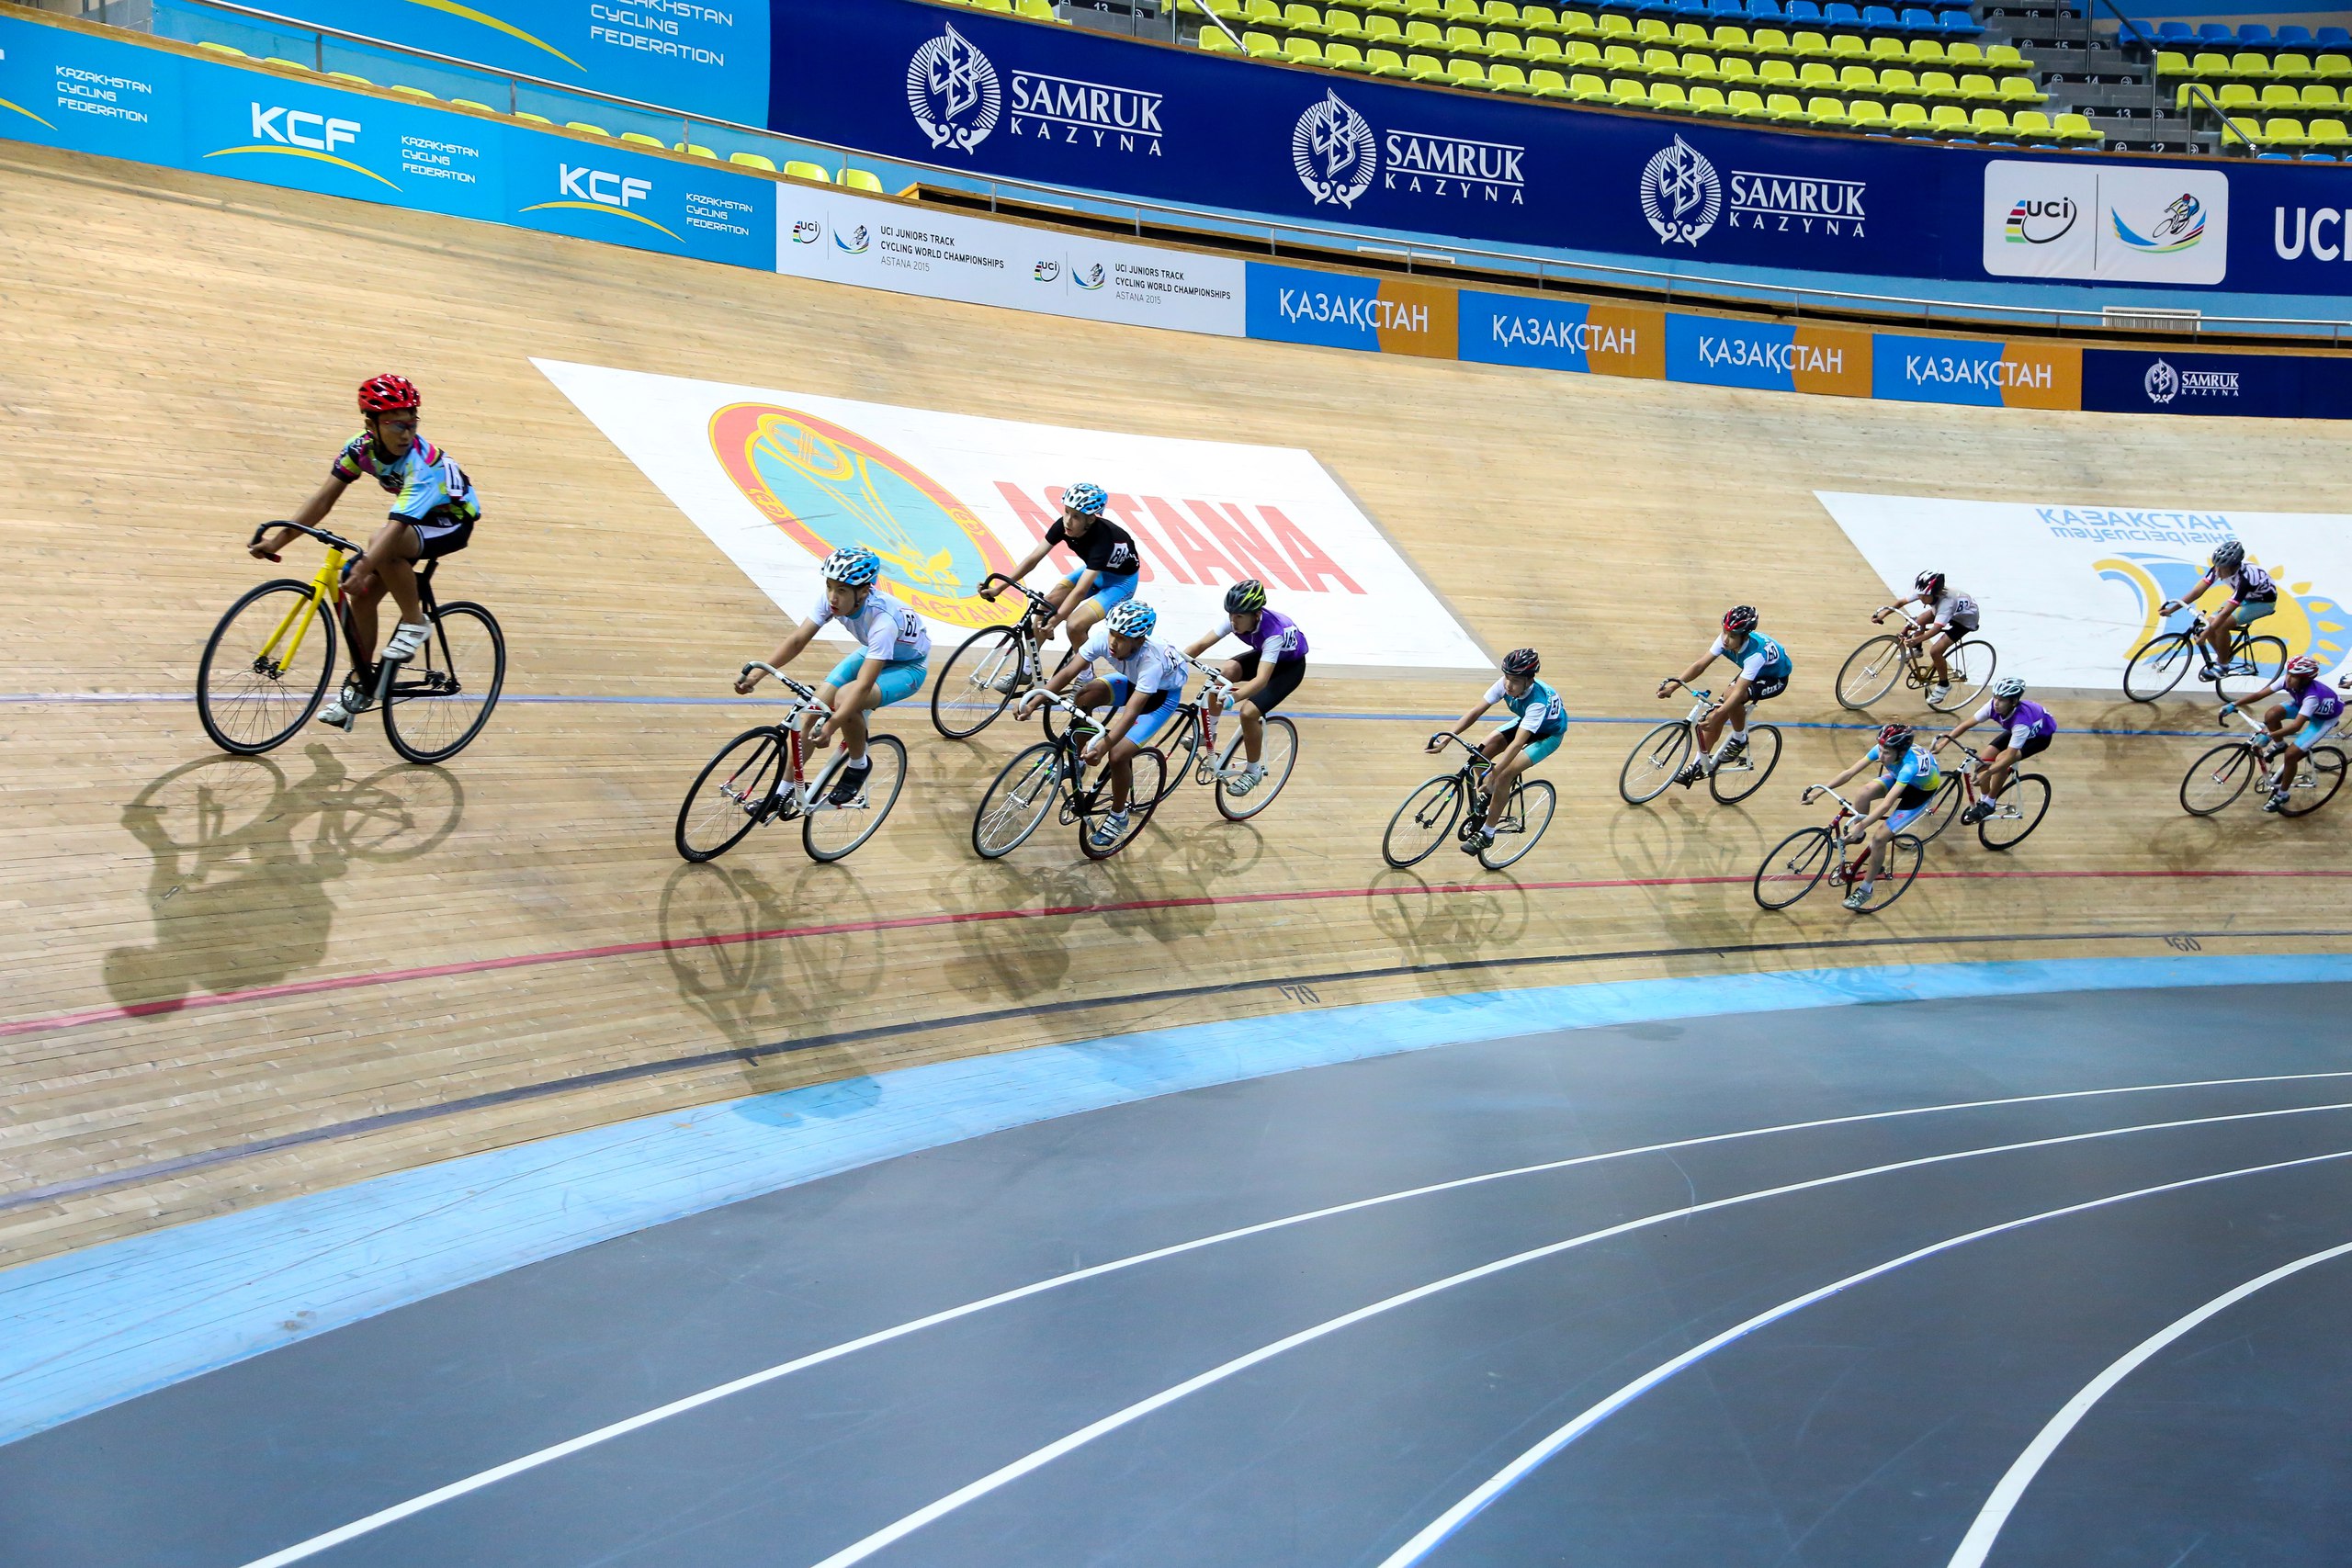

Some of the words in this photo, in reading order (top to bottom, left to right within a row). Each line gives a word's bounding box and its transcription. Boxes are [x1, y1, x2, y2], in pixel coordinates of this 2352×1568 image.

[591, 4, 679, 36] CYCLING
[617, 0, 733, 27] KHSTAN
[590, 26, 724, 67] FEDERATION
[55, 65, 152, 94] KAZAKHSTAN
[57, 81, 117, 103] CYCLING
[57, 96, 148, 123] FEDERATION
[1012, 75, 1162, 132] SAMRUK
[251, 101, 361, 152] KCF
[1011, 117, 1162, 157] KAZYNA
[401, 135, 480, 159] KAZAKHSTAN
[401, 148, 451, 166] CYCLING
[1385, 134, 1524, 182] SAMRUK
[402, 162, 476, 184] FEDERATION
[560, 163, 652, 208] KCF
[685, 192, 753, 213] KAZAKHSTAN
[1385, 173, 1523, 205] KAZYNA
[1730, 175, 1866, 216] SAMRUK
[686, 204, 729, 220] CYCLING
[1729, 211, 1865, 238] KAZYNA
[686, 217, 750, 236] FEDERATION
[880, 225, 894, 235] UCI
[896, 229, 928, 243] JUNIORS
[931, 233, 956, 247] TRACK
[2275, 207, 2352, 262] UCI
[880, 241, 912, 254] CYCLING
[915, 245, 942, 259] WORLD
[944, 251, 1004, 269] CHAMPIONSHIPS
[880, 256, 911, 269] ASTANA
[913, 261, 930, 272] 2015
[1114, 263, 1127, 273] UCI
[1129, 265, 1159, 277] JUNIORS
[1161, 269, 1184, 280] TRACK
[1115, 276, 1145, 288] CYCLING
[1147, 281, 1172, 292] WORLD
[1174, 285, 1231, 299] CHAMPIONSHIPS
[1115, 291, 1144, 302] ASTANA
[1146, 295, 1161, 305] 2015
[1280, 288, 1429, 333] ҚАЗАҚСТАН
[1493, 314, 1635, 355] ҚАЗАҚСТАН
[1699, 336, 1842, 374] ҚАЗАҚСТАН
[1906, 355, 2052, 389] ҚАЗАҚСТАН
[2182, 373, 2239, 388] SAMRUK
[2181, 389, 2239, 397] KAZYNA
